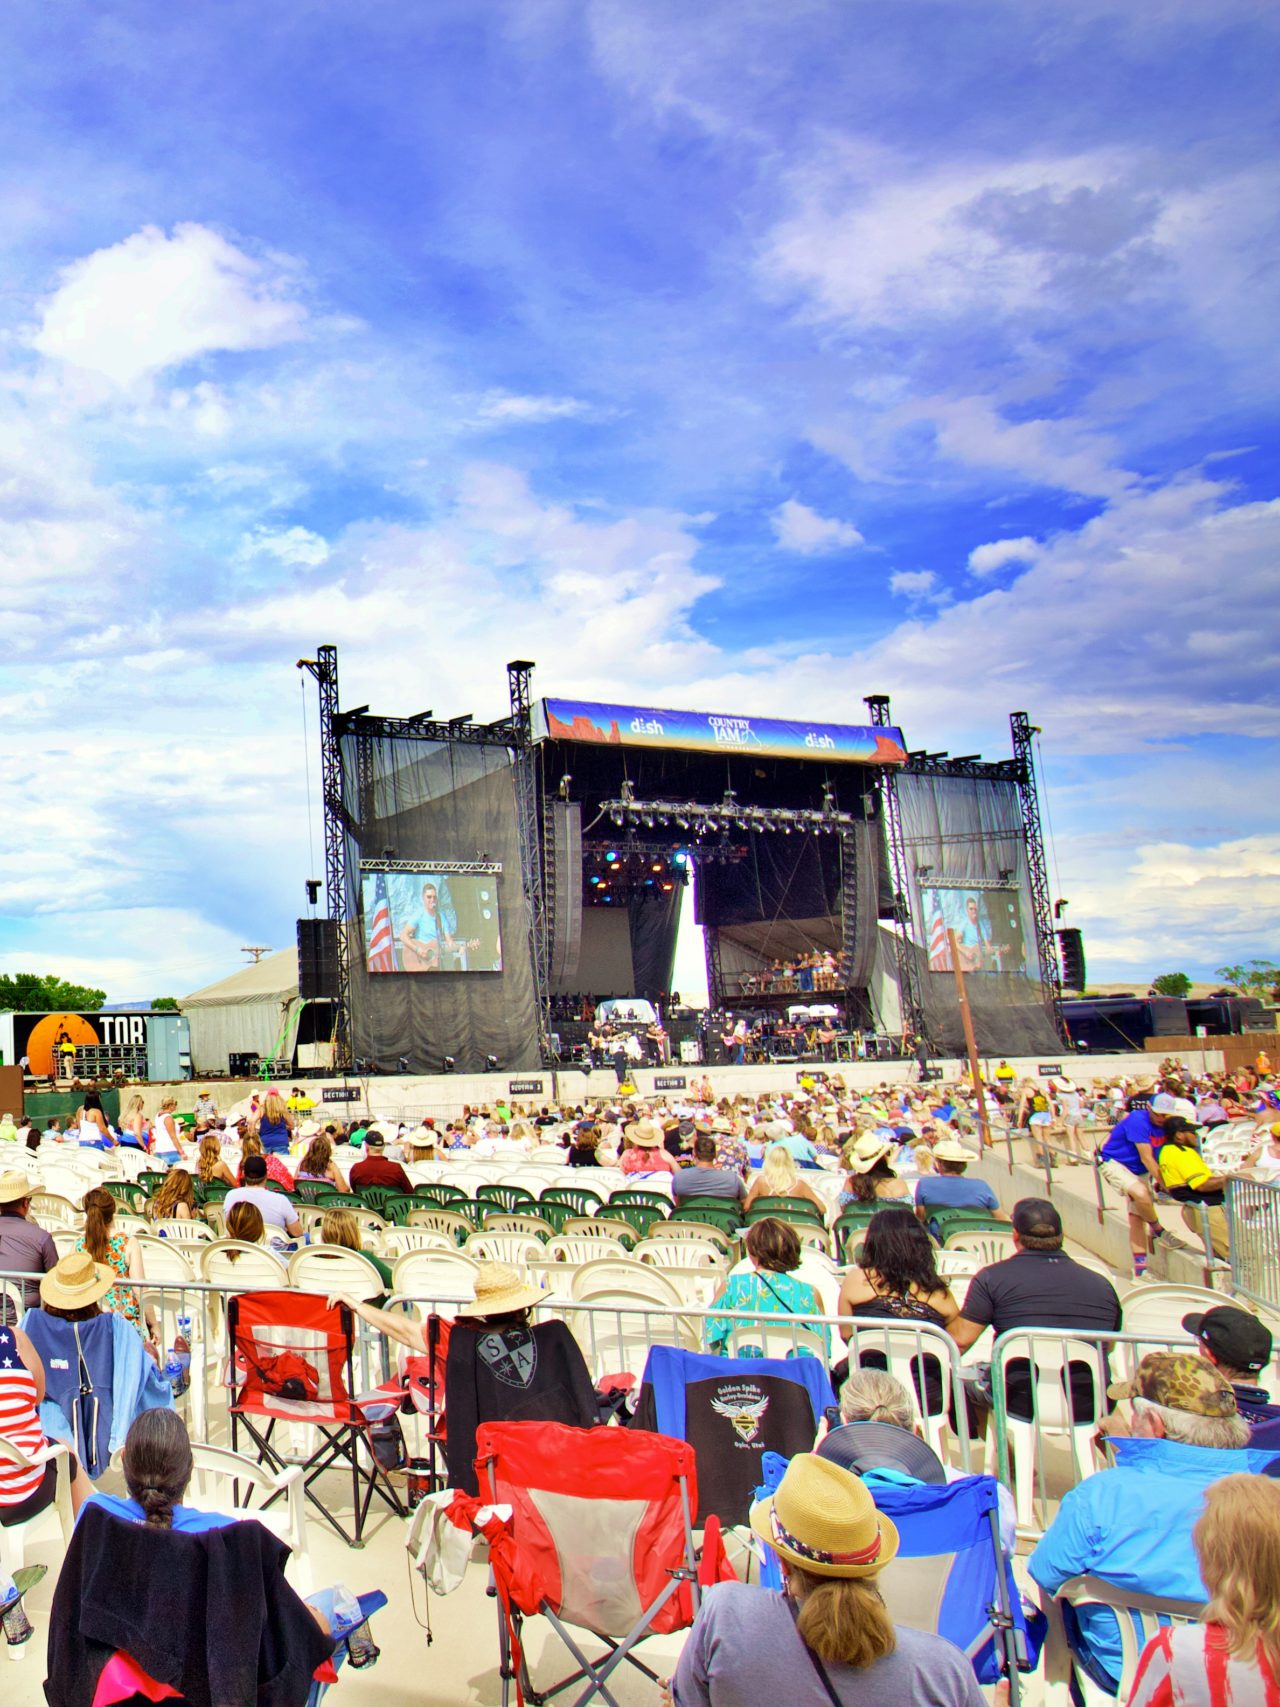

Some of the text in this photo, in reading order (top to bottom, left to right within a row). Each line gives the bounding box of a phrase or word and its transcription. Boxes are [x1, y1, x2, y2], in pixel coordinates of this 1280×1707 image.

[630, 717, 664, 735] dish
[708, 716, 750, 729] COUNTRY
[713, 725, 740, 744] JAM
[805, 732, 835, 749] dish
[99, 1016, 147, 1045] TOB
[323, 1091, 349, 1099] SECTION
[486, 1338, 500, 1358] S
[518, 1351, 531, 1368] A
